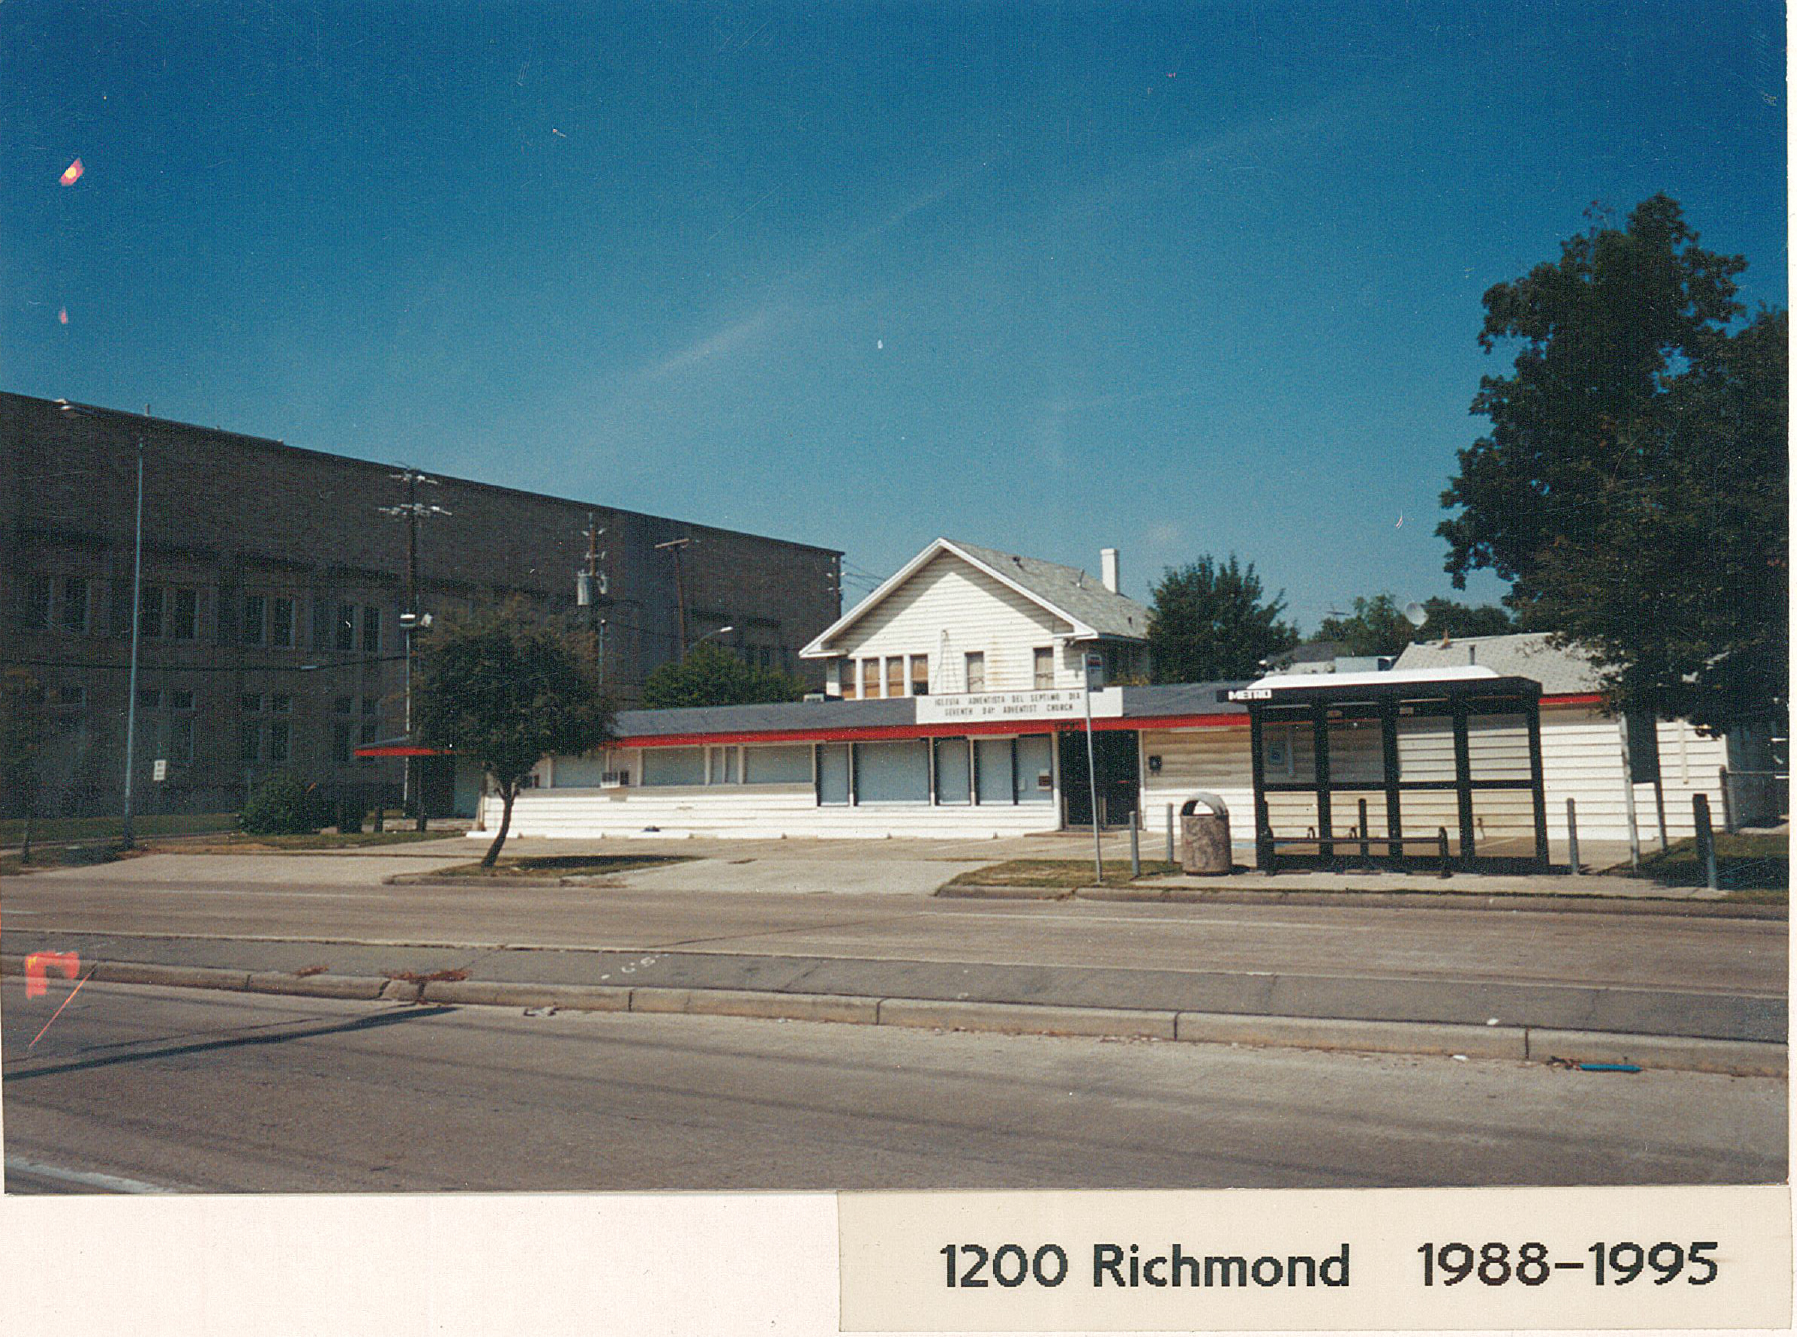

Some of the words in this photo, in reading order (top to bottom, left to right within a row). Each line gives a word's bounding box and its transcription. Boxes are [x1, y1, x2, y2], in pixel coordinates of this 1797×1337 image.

[1012, 694, 1024, 703] DEL
[1068, 692, 1080, 700] DIA
[1228, 689, 1272, 700] METRO
[945, 707, 973, 717] SEVENTH
[982, 706, 996, 715] DAY
[1003, 704, 1037, 713] ADVENTIST
[1046, 703, 1073, 712] CHURCH
